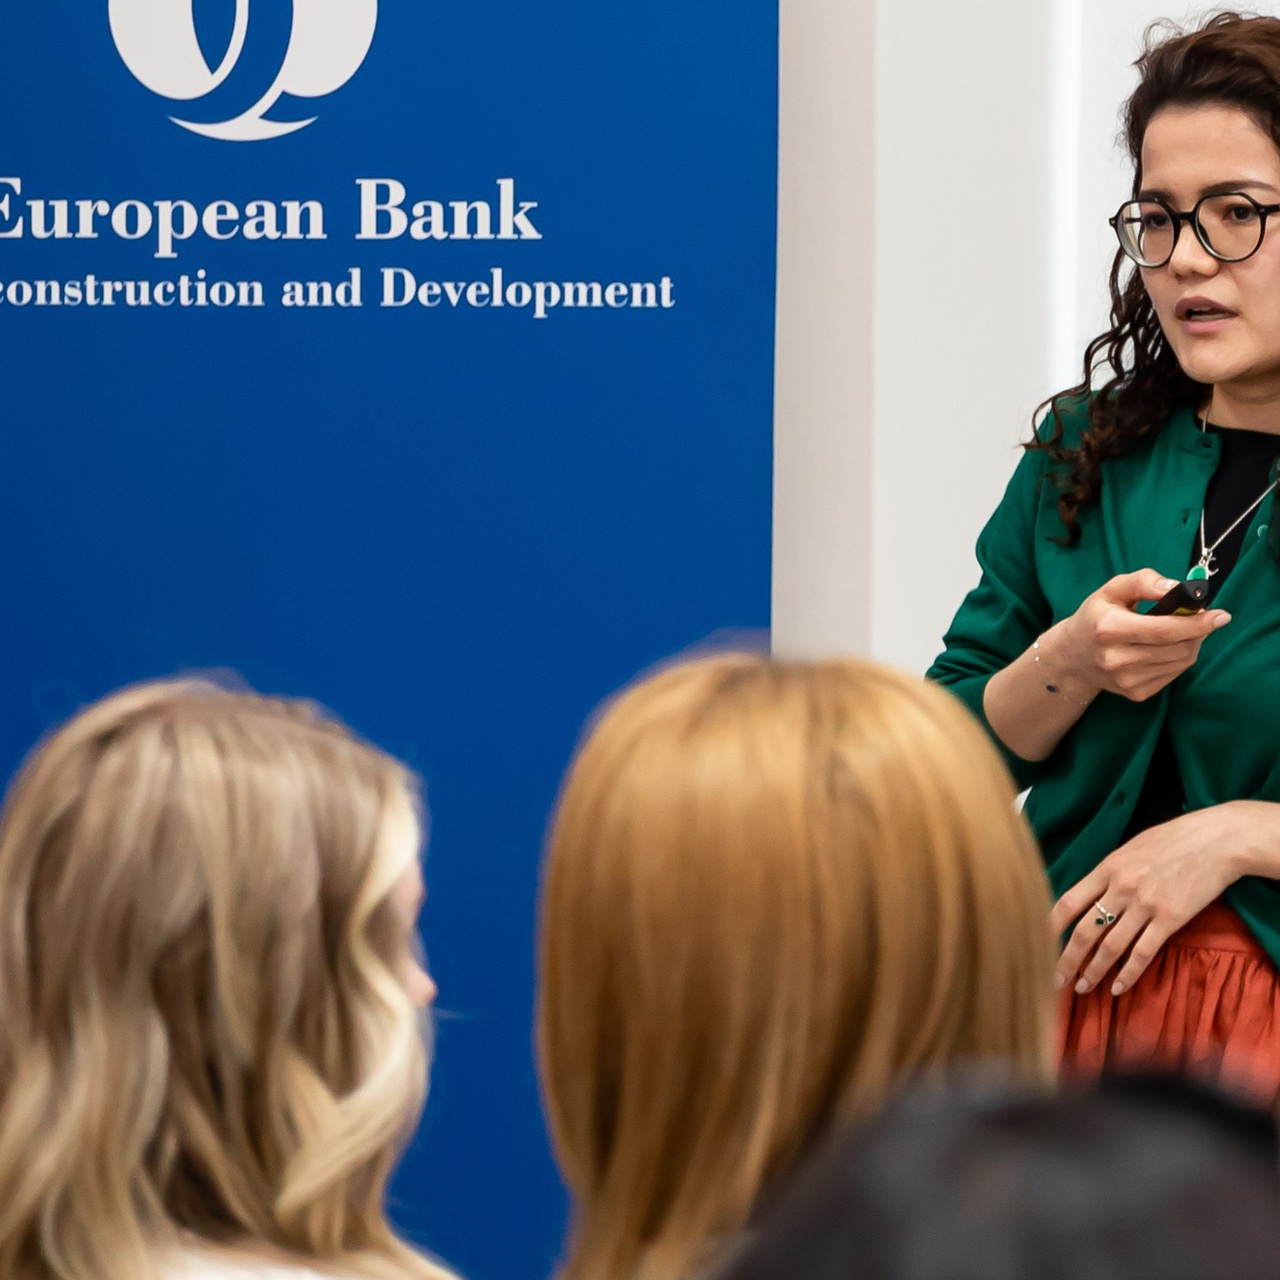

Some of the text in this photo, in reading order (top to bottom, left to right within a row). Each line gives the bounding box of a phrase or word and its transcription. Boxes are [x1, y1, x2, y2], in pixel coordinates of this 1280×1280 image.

[354, 177, 543, 240] Bank
[0, 267, 676, 319] onstruction and Development
